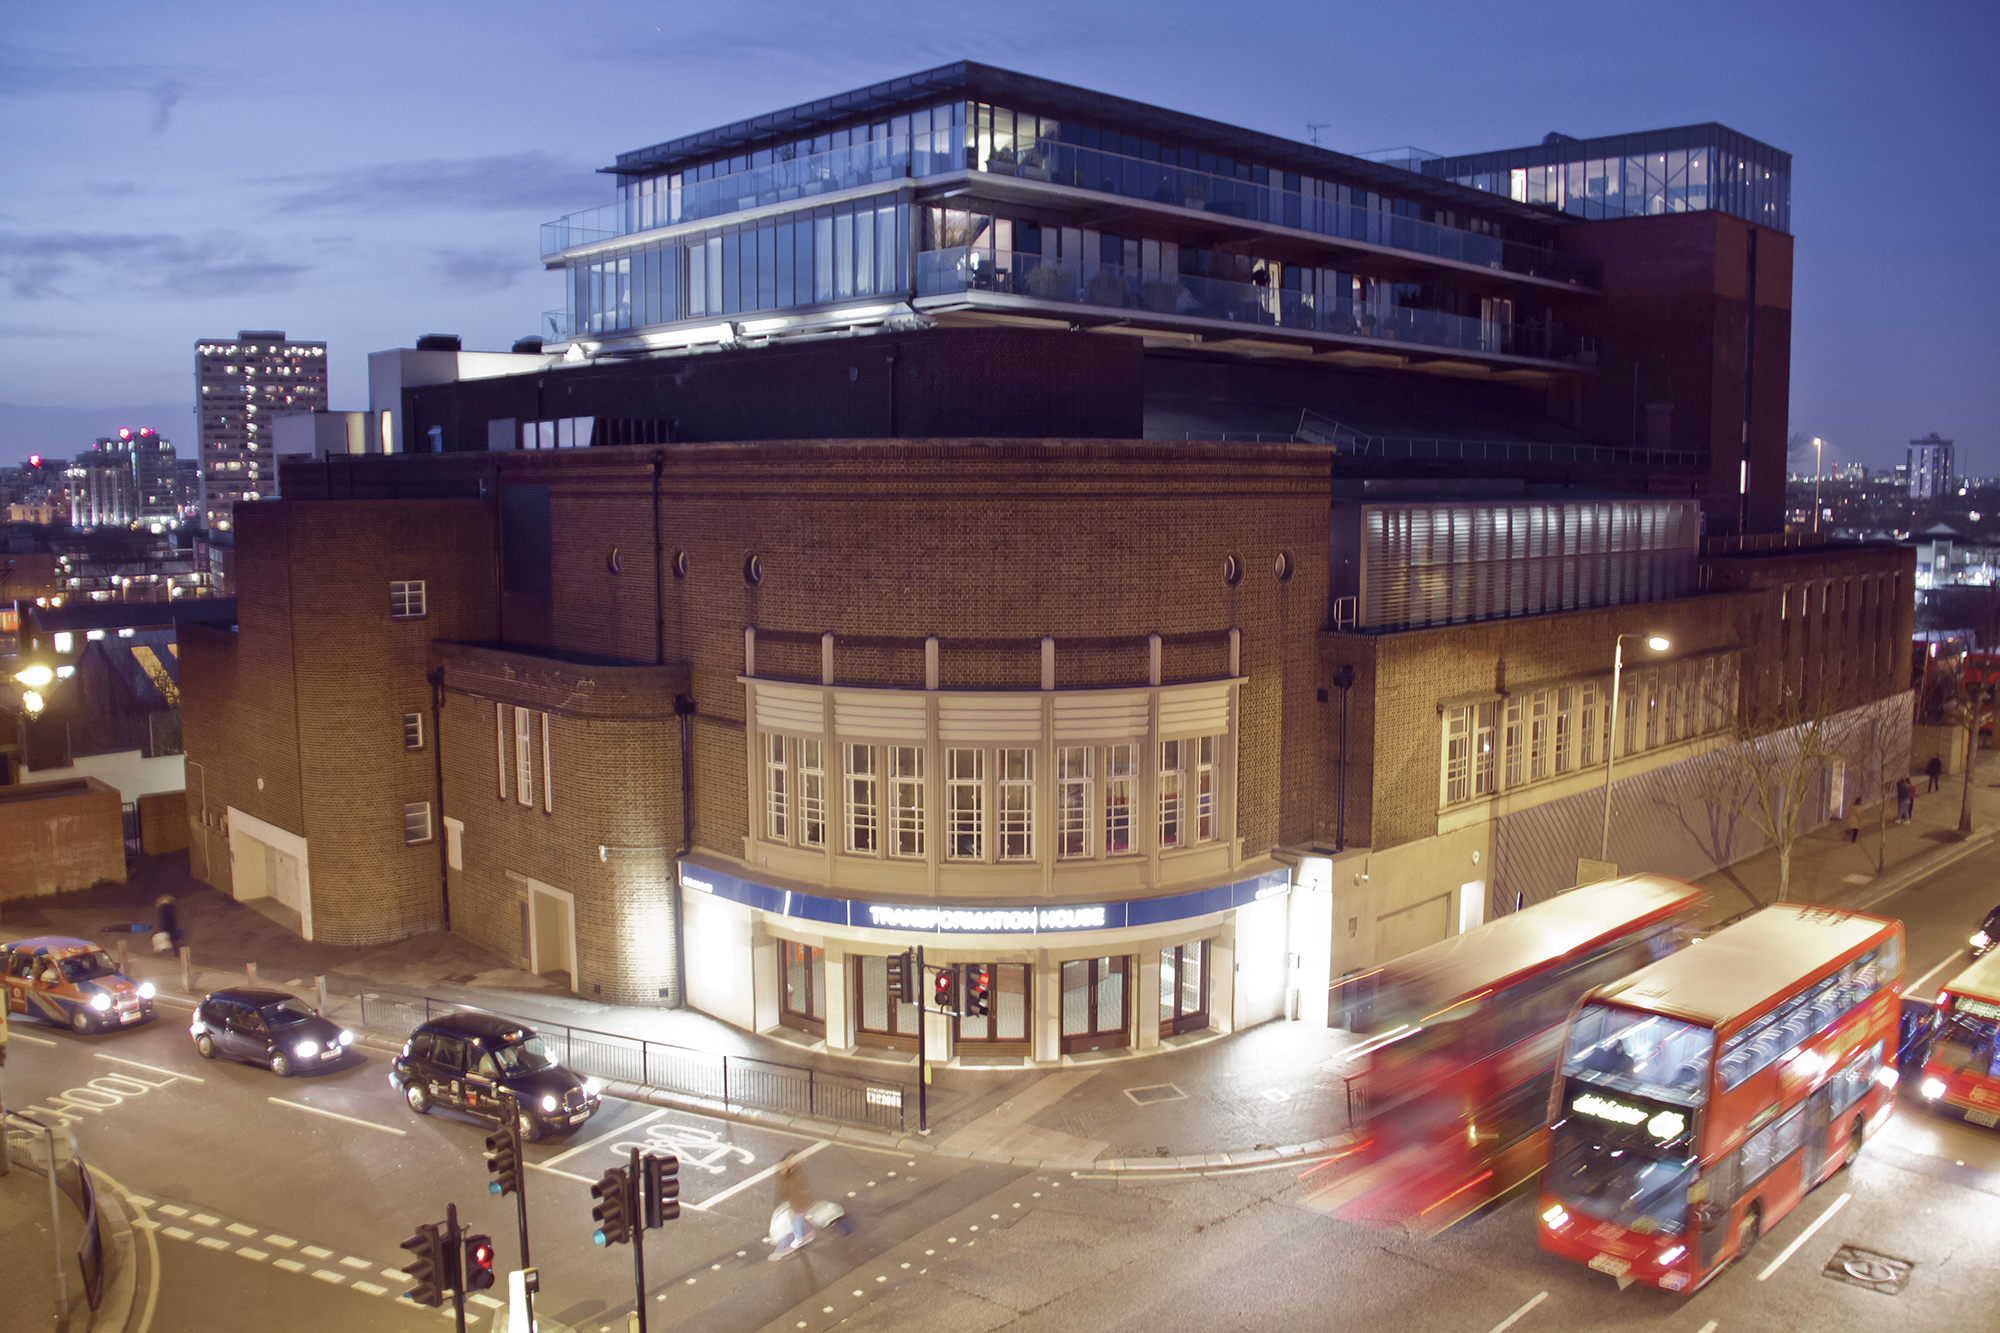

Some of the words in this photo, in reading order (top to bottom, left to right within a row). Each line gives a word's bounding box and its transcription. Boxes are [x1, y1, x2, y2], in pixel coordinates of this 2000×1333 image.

[868, 906, 1036, 930] TRANSFORMATION
[1039, 907, 1105, 929] HOUSE
[2, 1072, 178, 1137] CHOOL
